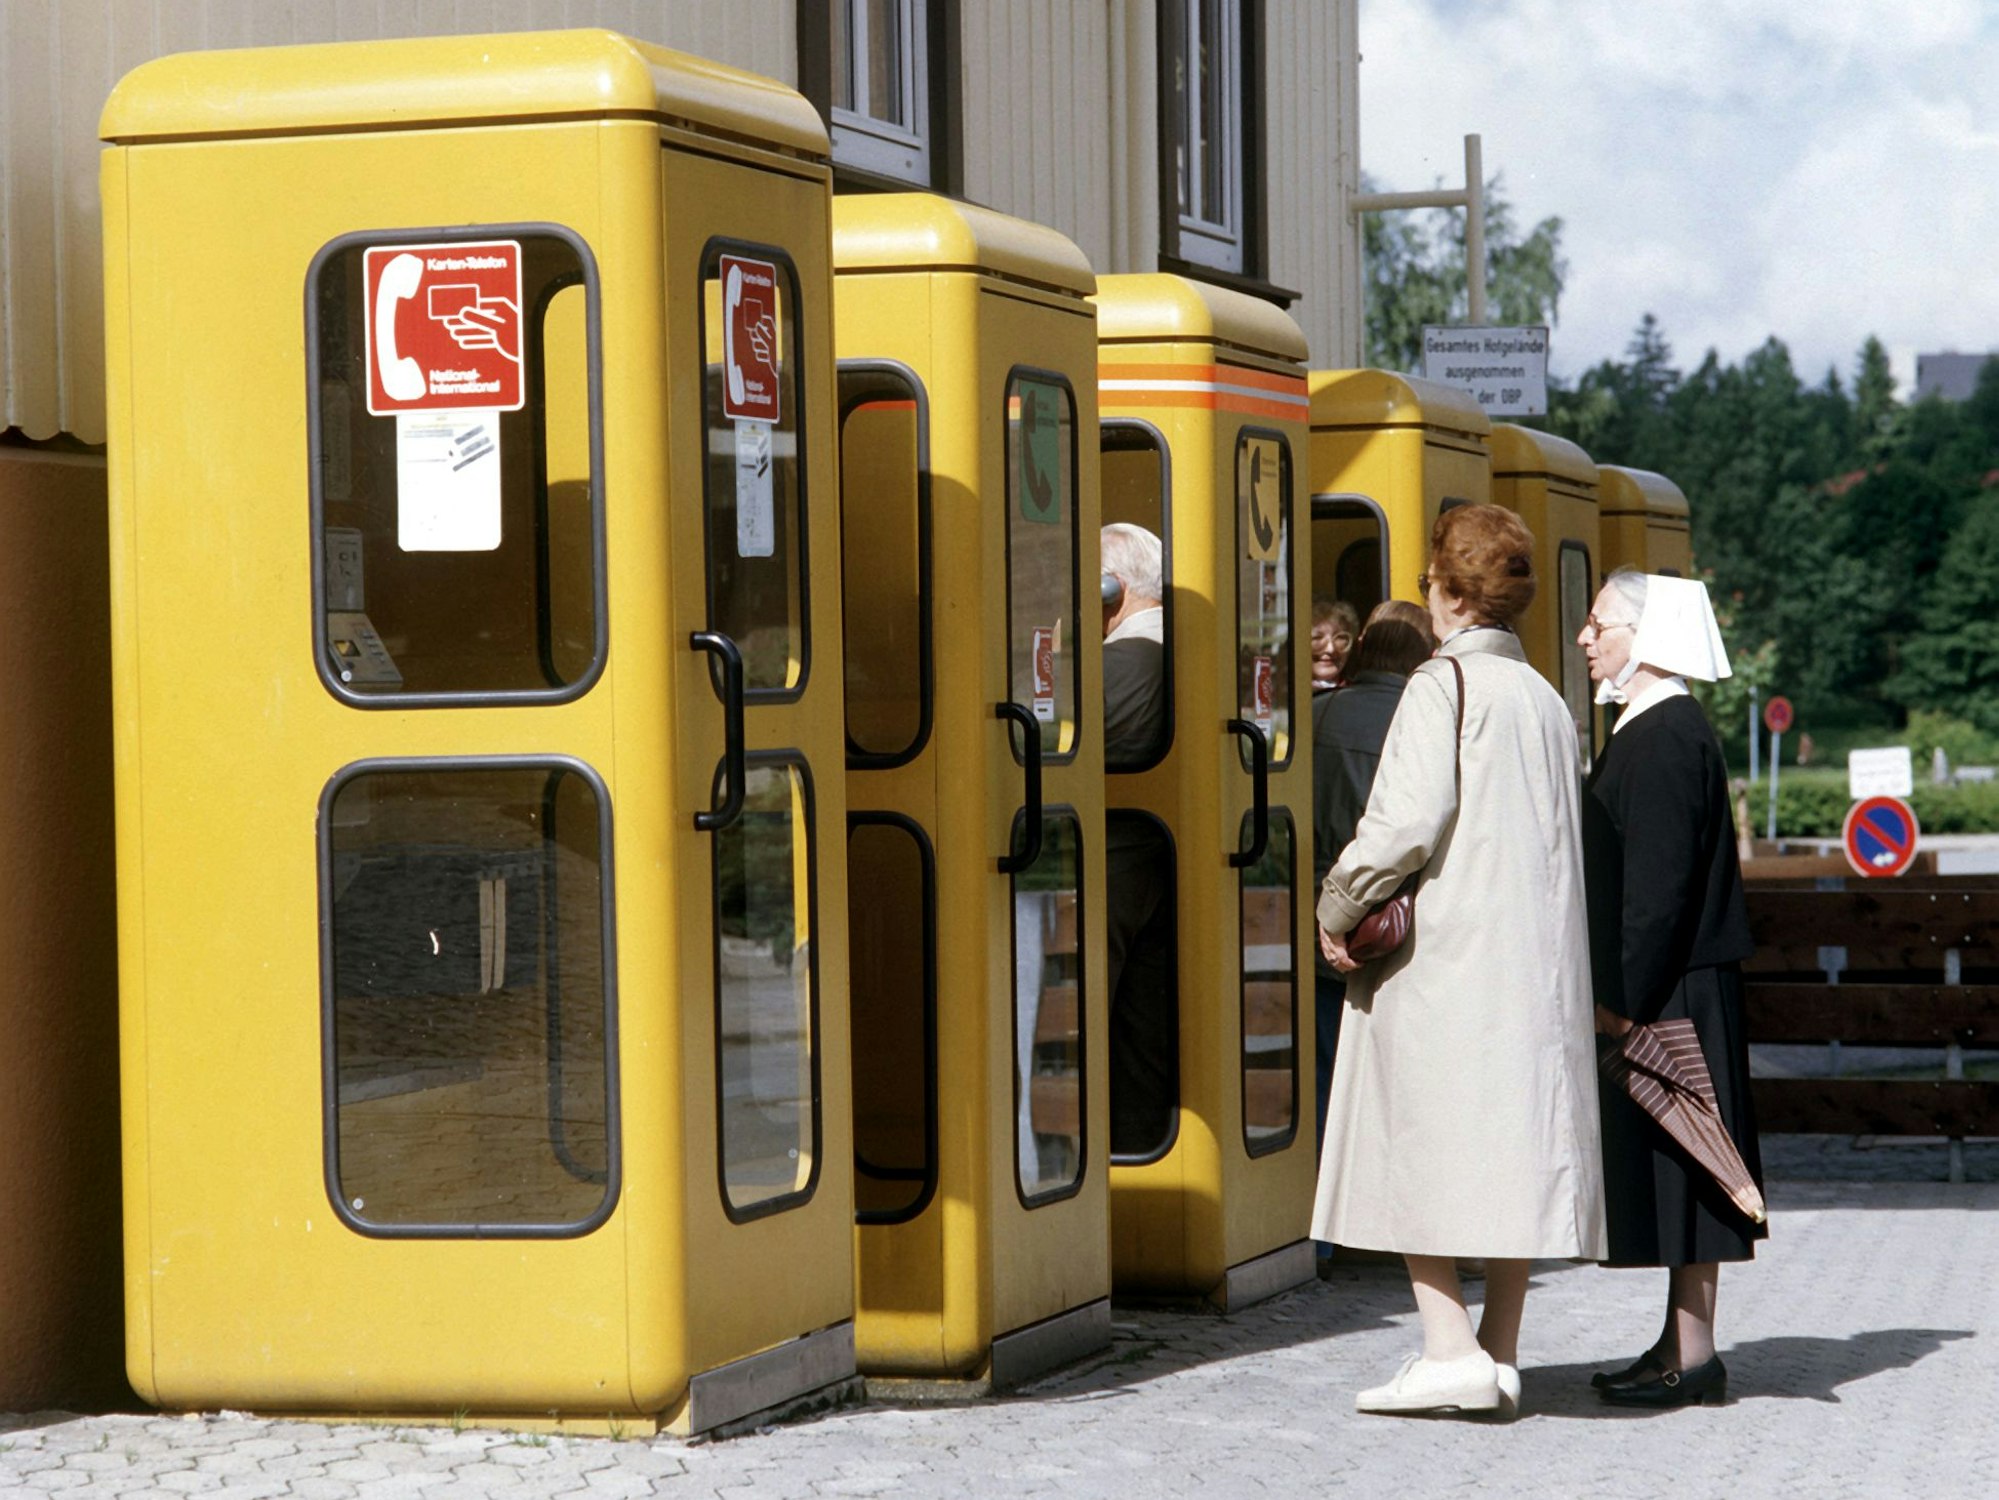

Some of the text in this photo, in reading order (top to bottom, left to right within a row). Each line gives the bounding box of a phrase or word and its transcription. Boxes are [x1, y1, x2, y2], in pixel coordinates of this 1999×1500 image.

[427, 256, 507, 271] Karten-Telefon
[1426, 337, 1480, 353] Gesamtes
[1445, 366, 1525, 382] ausgenommen
[429, 379, 500, 395] International
[1477, 388, 1496, 404] der
